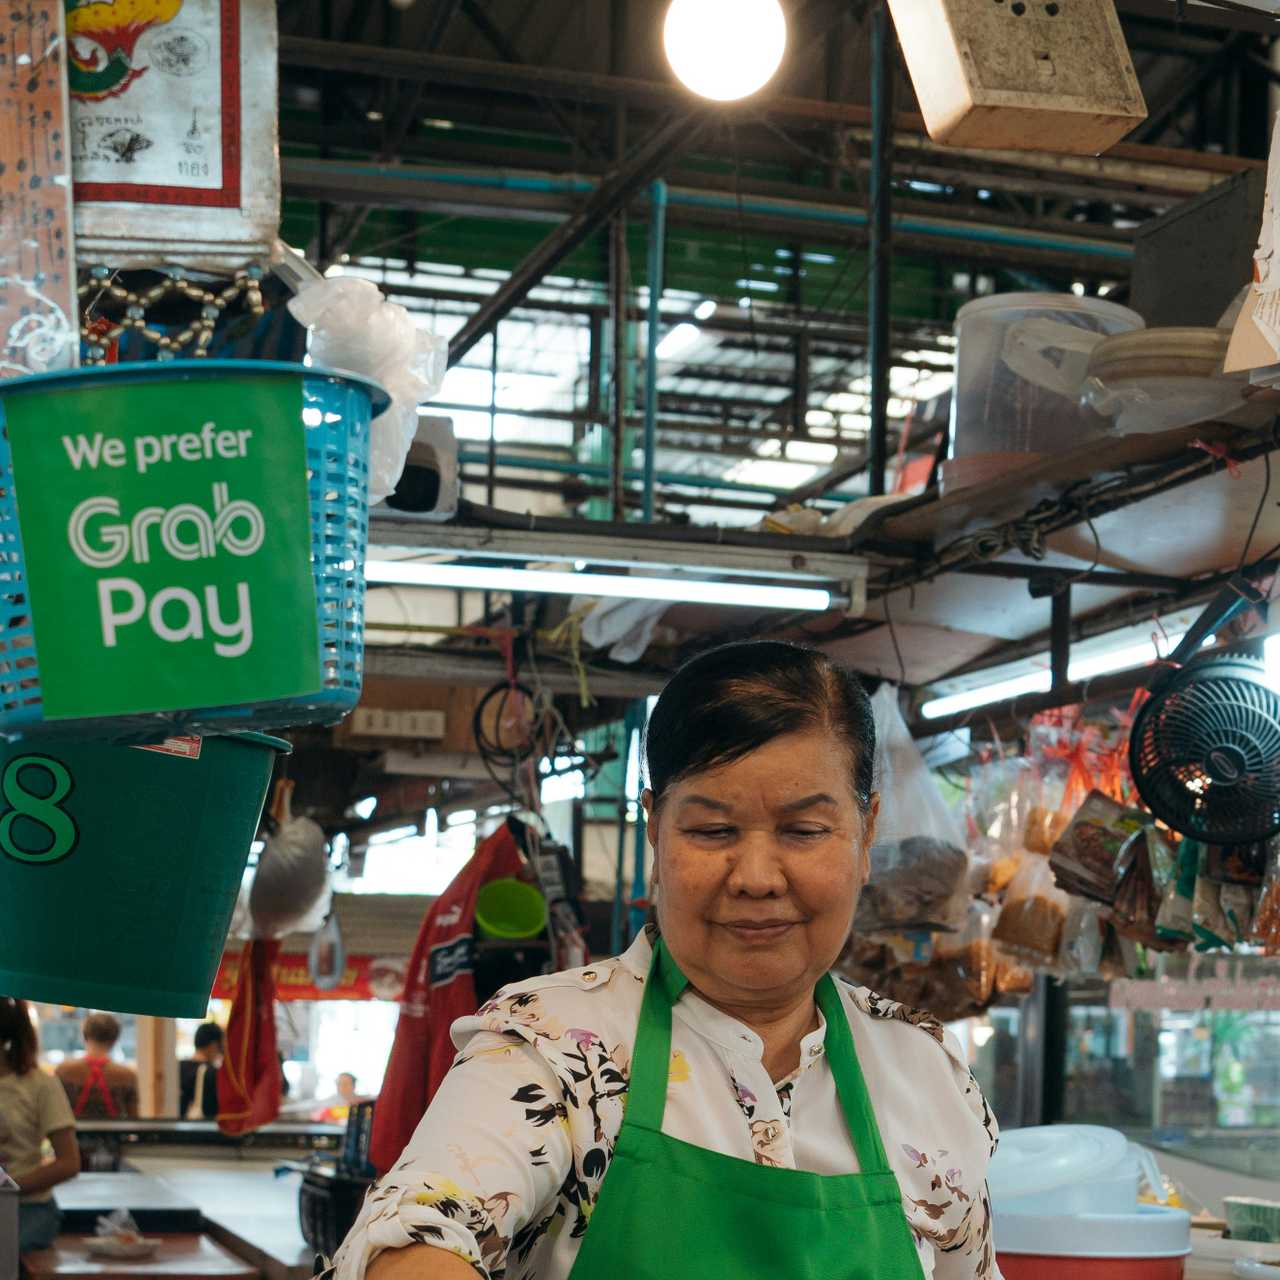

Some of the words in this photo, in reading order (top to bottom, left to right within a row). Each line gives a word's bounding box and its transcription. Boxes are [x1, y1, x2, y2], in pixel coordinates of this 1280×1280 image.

[62, 432, 127, 471] We
[134, 422, 252, 474] prefer
[67, 481, 265, 569] Grab
[96, 576, 254, 658] Pay
